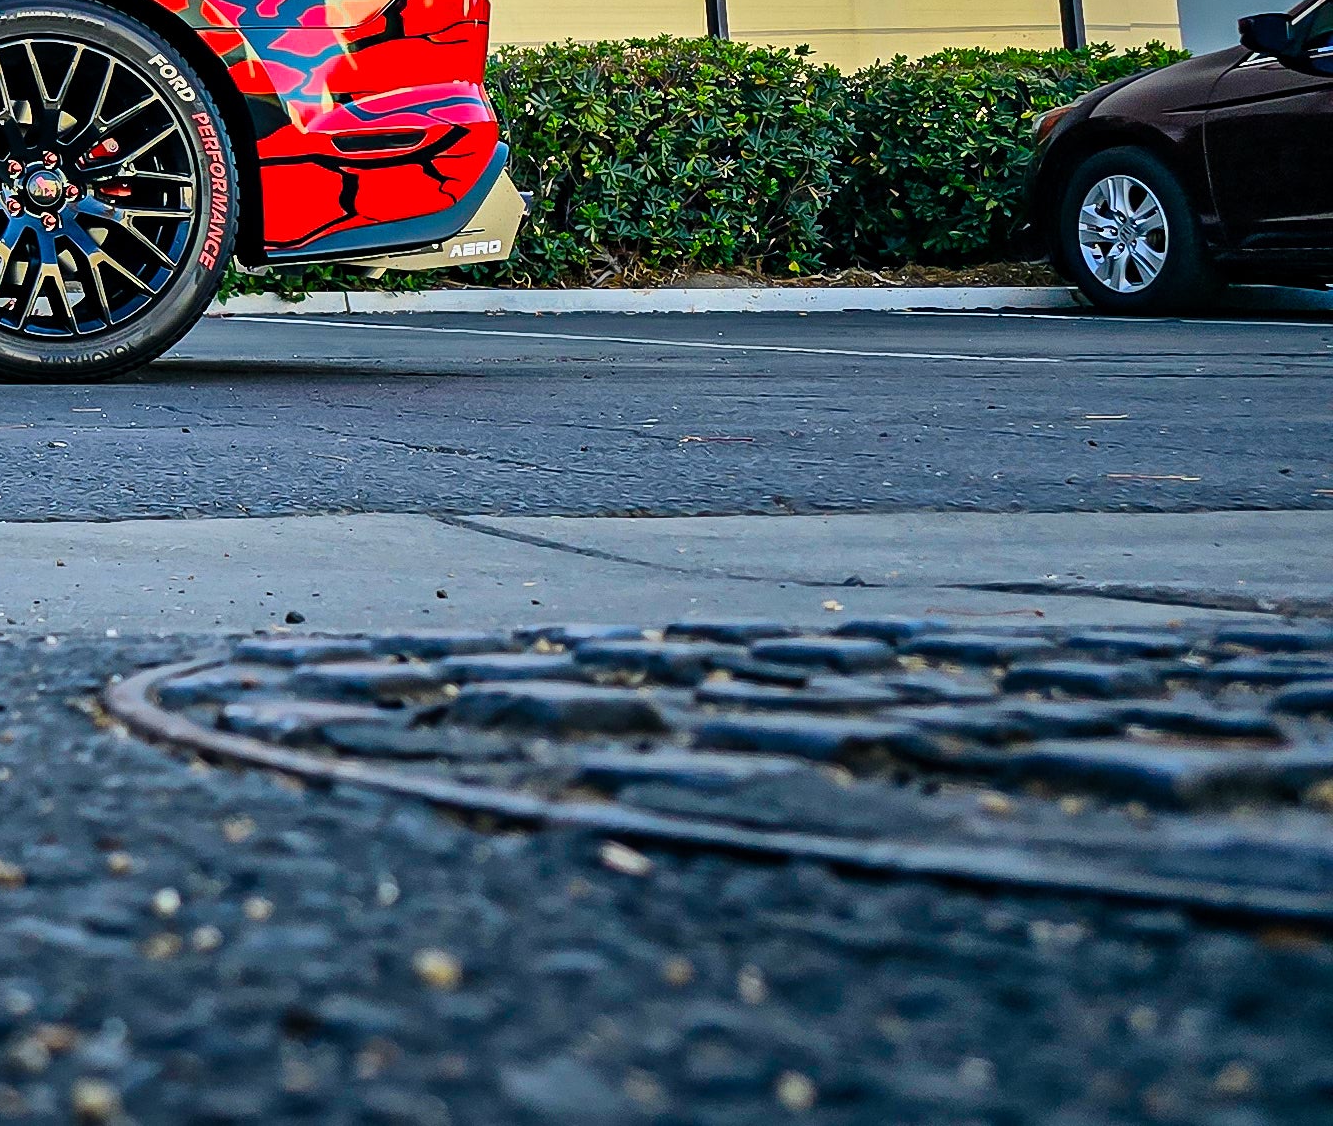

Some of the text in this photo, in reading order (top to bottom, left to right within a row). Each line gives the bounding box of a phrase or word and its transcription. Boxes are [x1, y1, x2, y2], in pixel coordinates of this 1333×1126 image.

[147, 53, 229, 272] FORD PERFORMANCE
[449, 239, 502, 258] AERO
